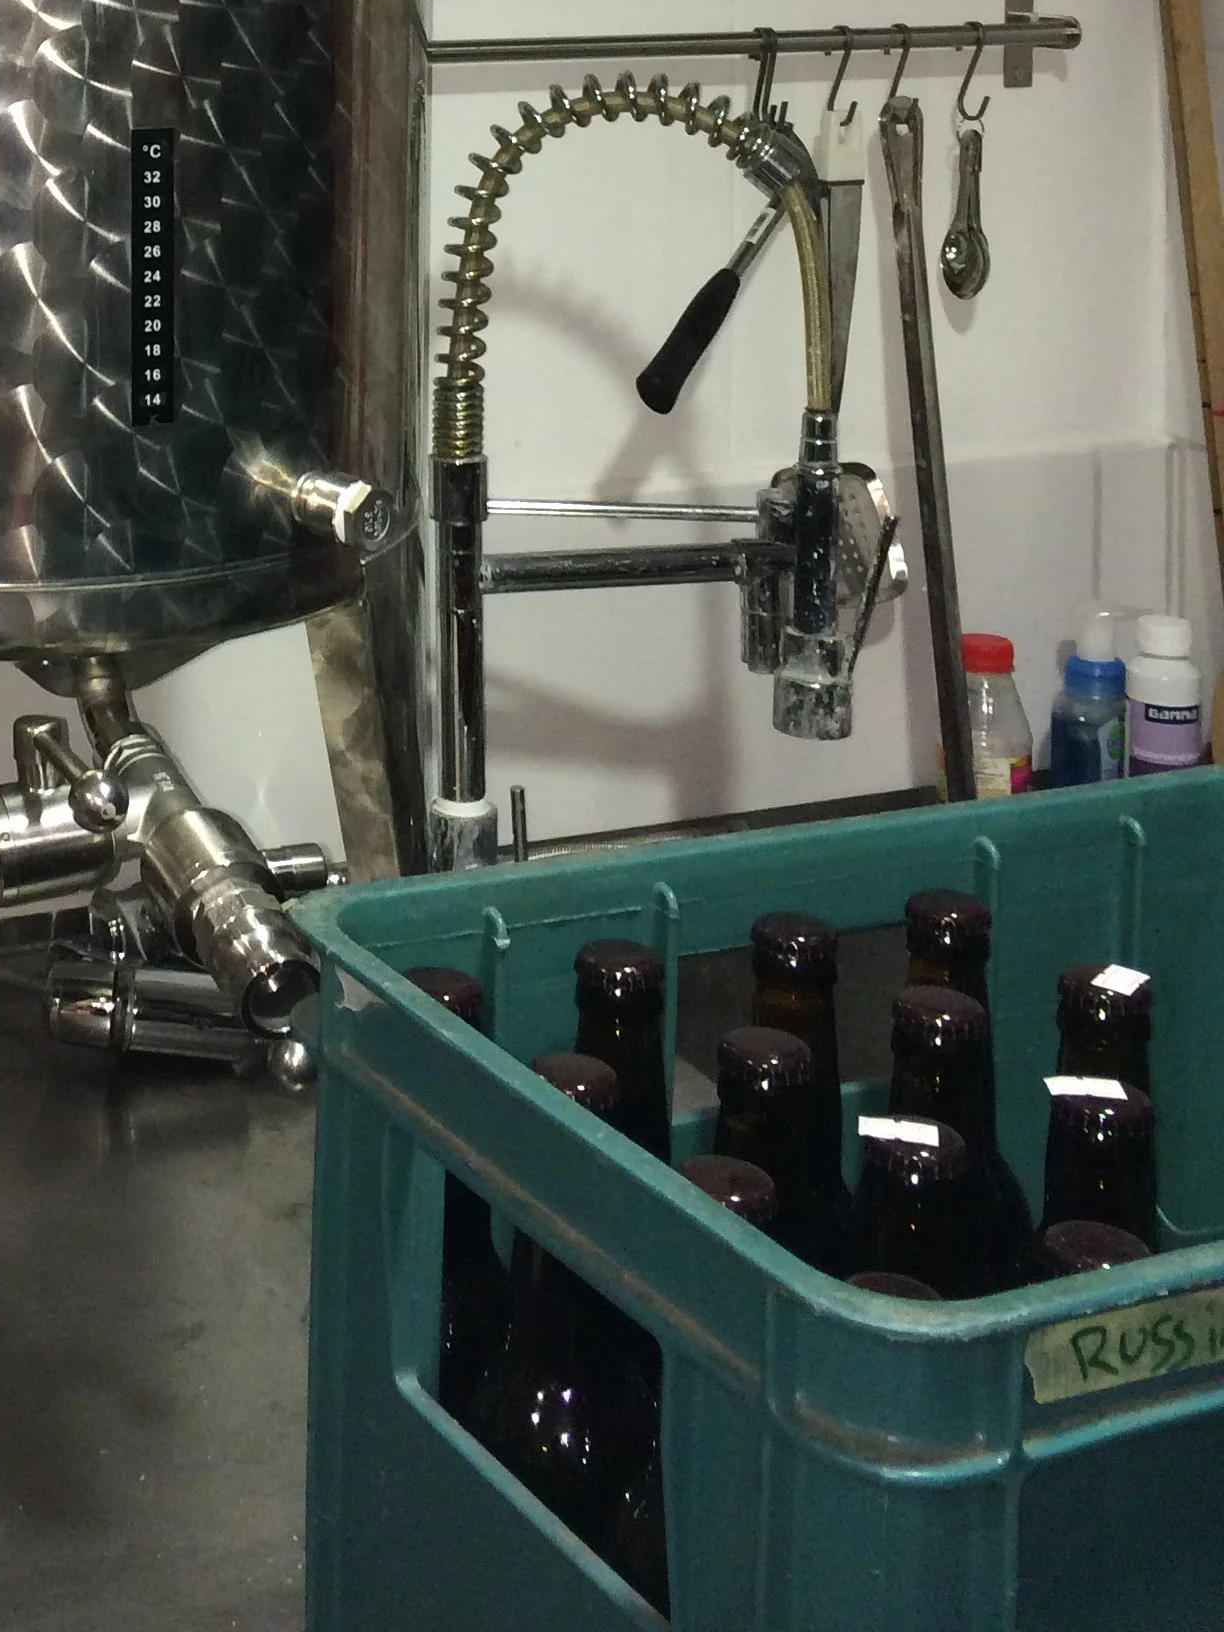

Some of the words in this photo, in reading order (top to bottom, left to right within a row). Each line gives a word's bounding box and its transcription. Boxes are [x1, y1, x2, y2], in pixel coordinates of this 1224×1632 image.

[142, 144, 162, 159] °C
[143, 171, 162, 184] 32
[143, 196, 162, 208] 30
[143, 221, 162, 234] 28
[143, 245, 162, 258] 26
[143, 270, 162, 283] 24
[143, 295, 162, 308] 22
[143, 319, 162, 332] 20
[143, 344, 162, 357] 18
[143, 369, 162, 382] 16
[143, 394, 162, 407] 14
